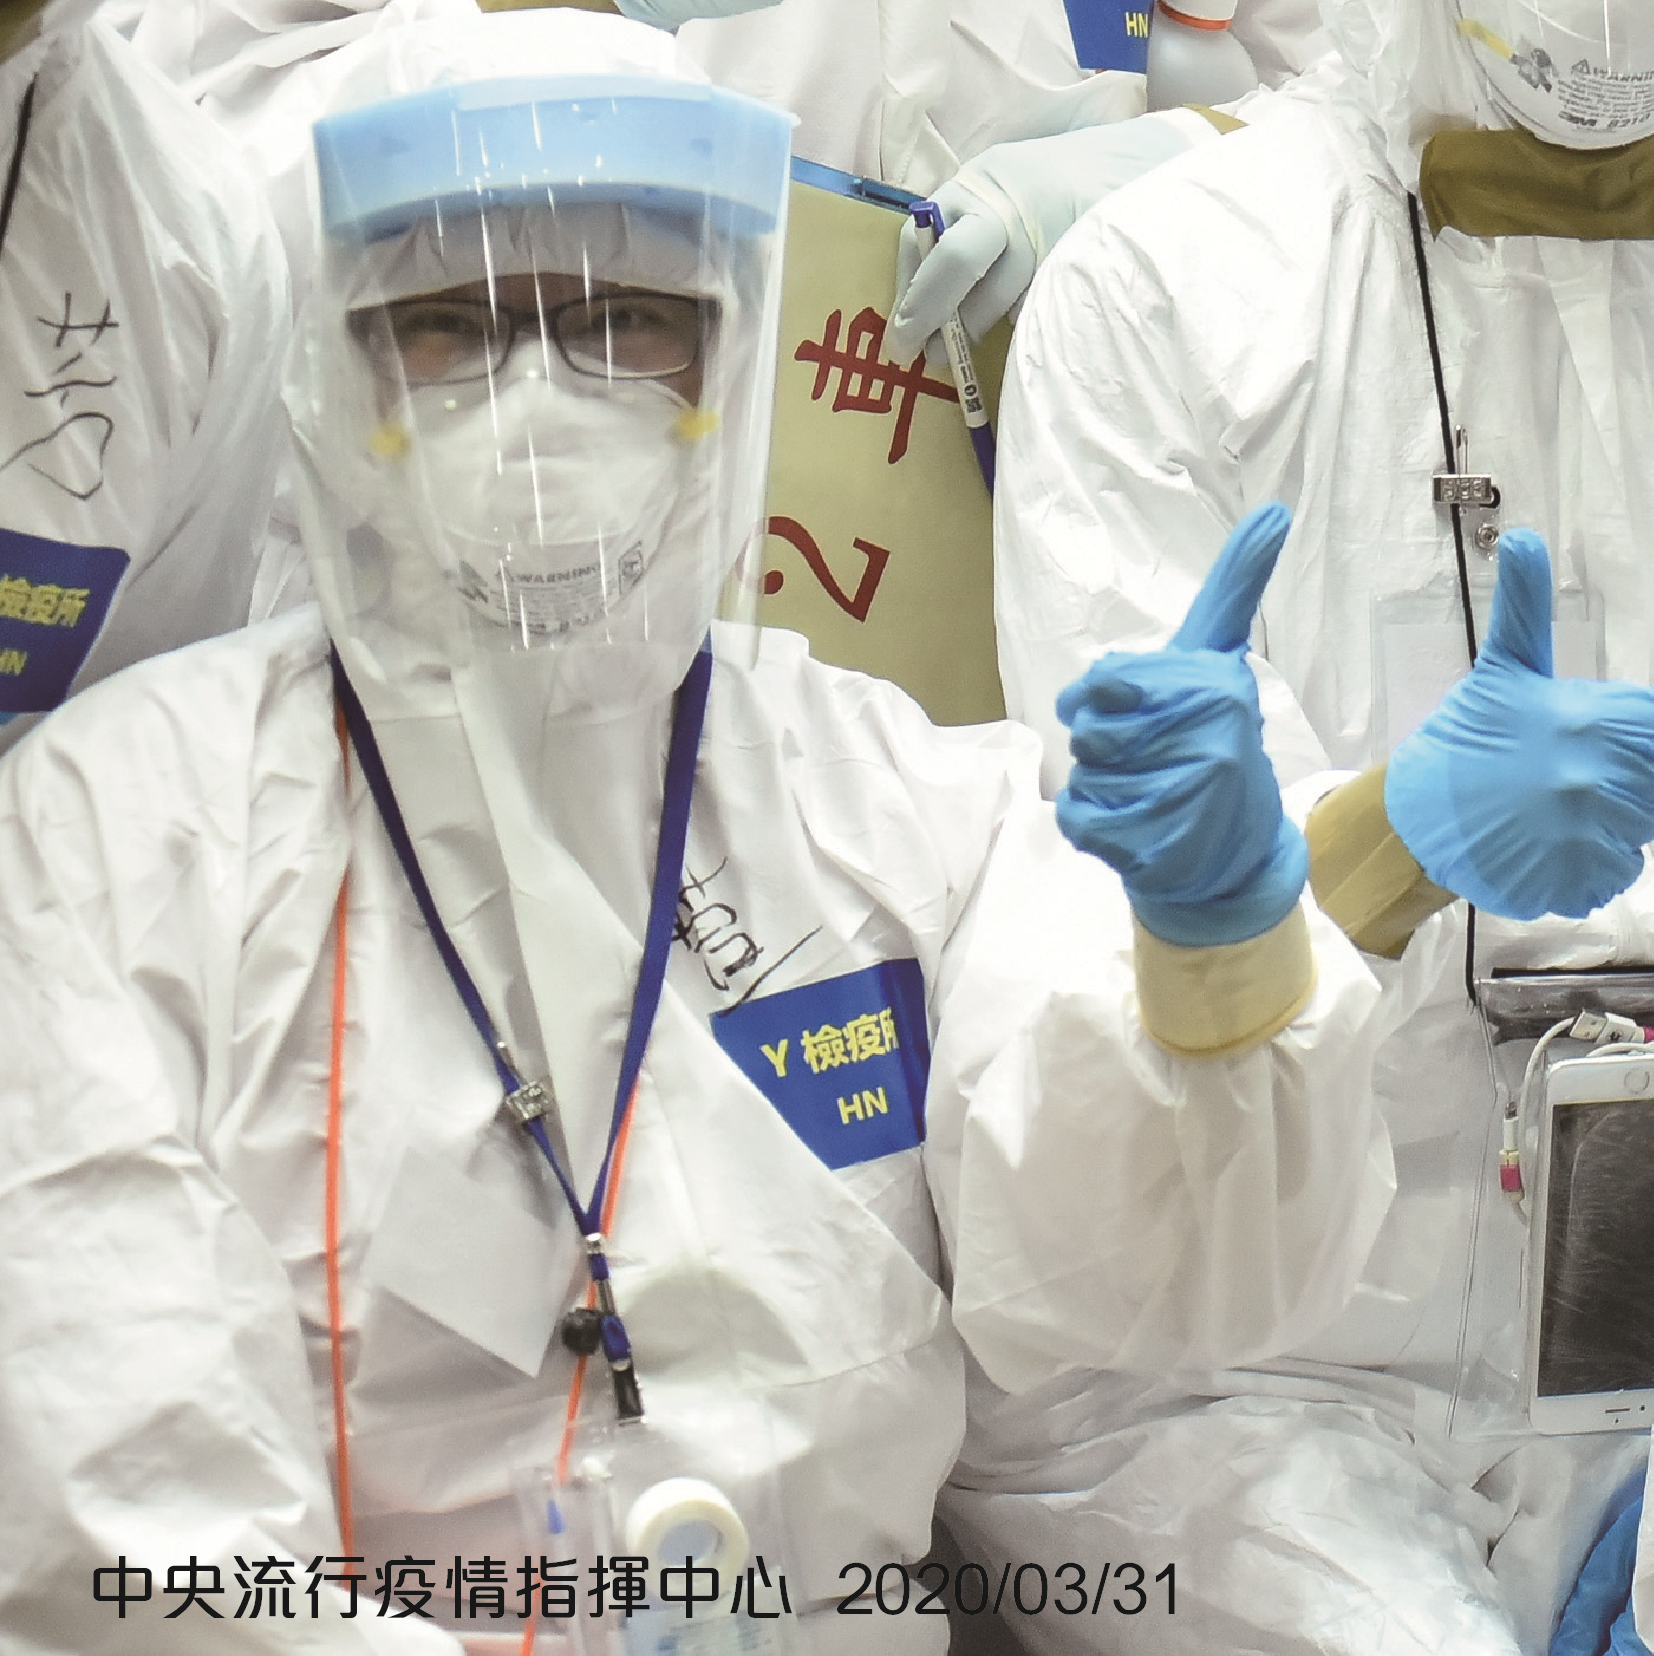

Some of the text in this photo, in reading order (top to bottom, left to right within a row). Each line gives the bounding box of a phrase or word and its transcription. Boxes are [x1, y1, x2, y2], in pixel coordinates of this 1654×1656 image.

[1125, 11, 1150, 38] HN
[760, 1038, 789, 1078] Y
[837, 1086, 889, 1126] HN
